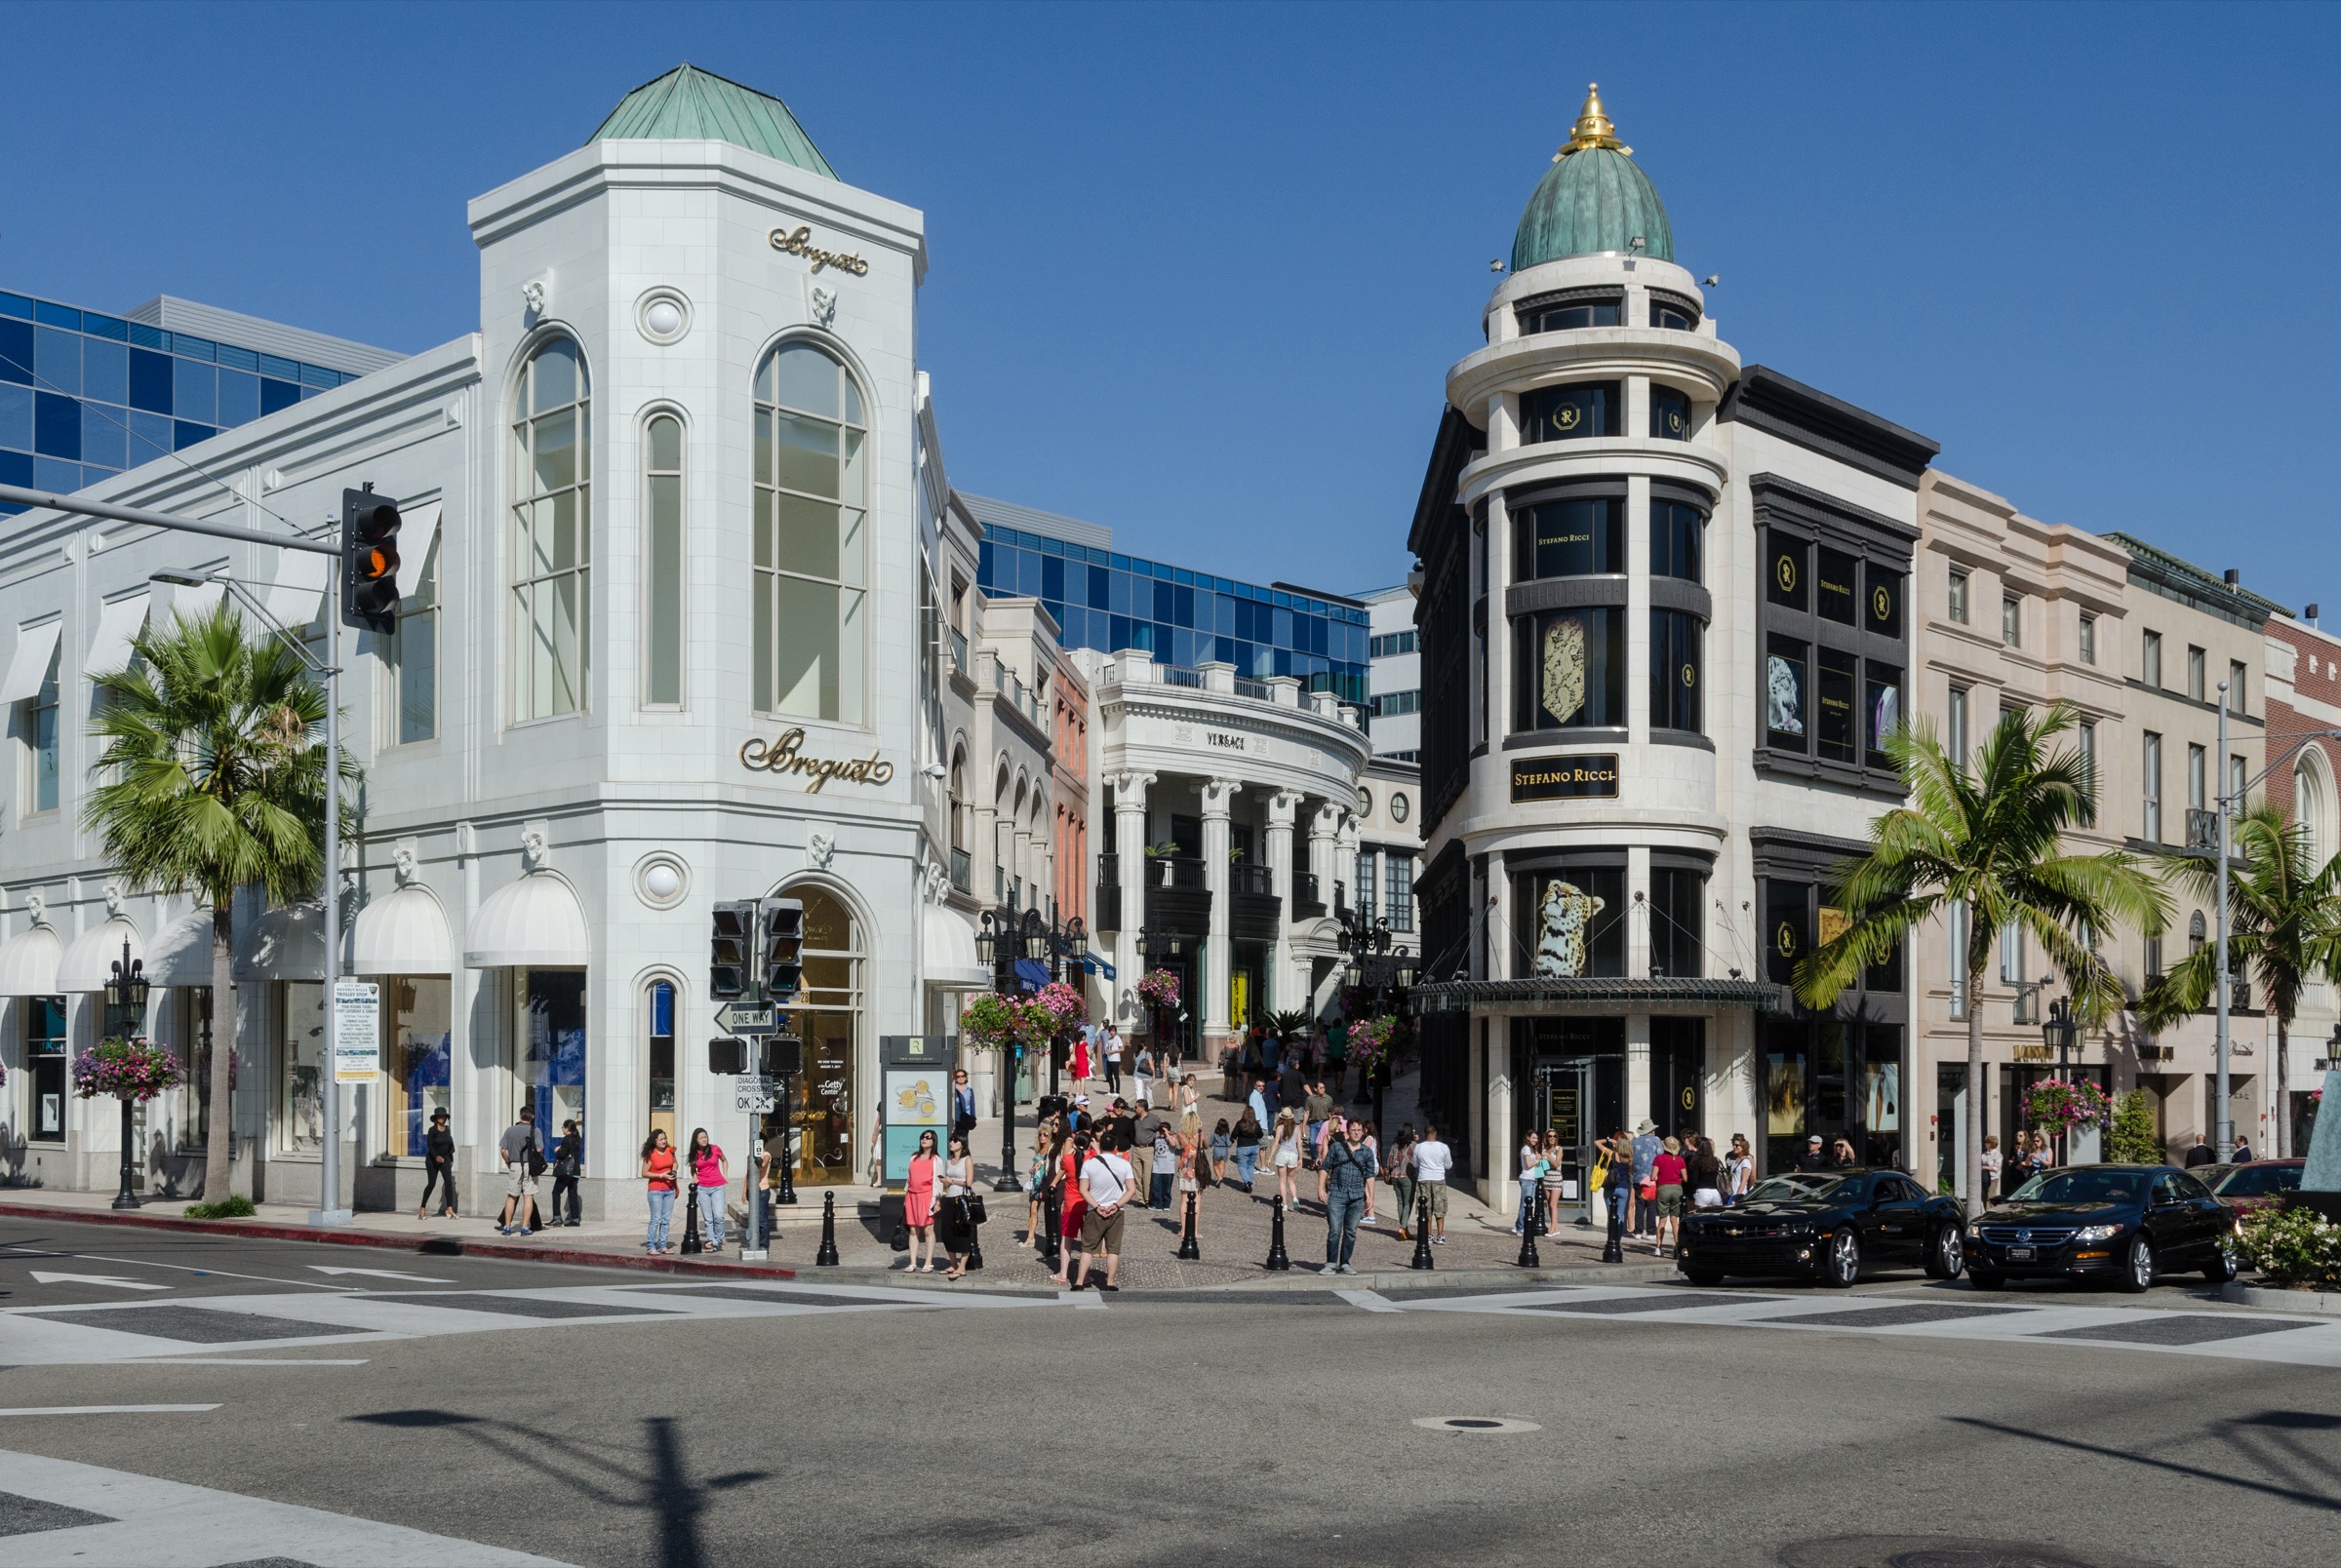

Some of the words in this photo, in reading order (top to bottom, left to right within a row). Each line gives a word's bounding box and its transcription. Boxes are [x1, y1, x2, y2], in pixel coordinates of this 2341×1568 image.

[768, 226, 868, 277] Breguet
[1538, 536, 1568, 545] STEFANO
[1207, 732, 1245, 750] VERSACE
[738, 727, 893, 794] Breguet
[1515, 771, 1570, 786] STEFANO
[1573, 768, 1613, 782] RICCI
[733, 1013, 749, 1024] ONE
[752, 1012, 769, 1024] WAY
[824, 1079, 844, 1090] Getty
[737, 1097, 750, 1109] OK
